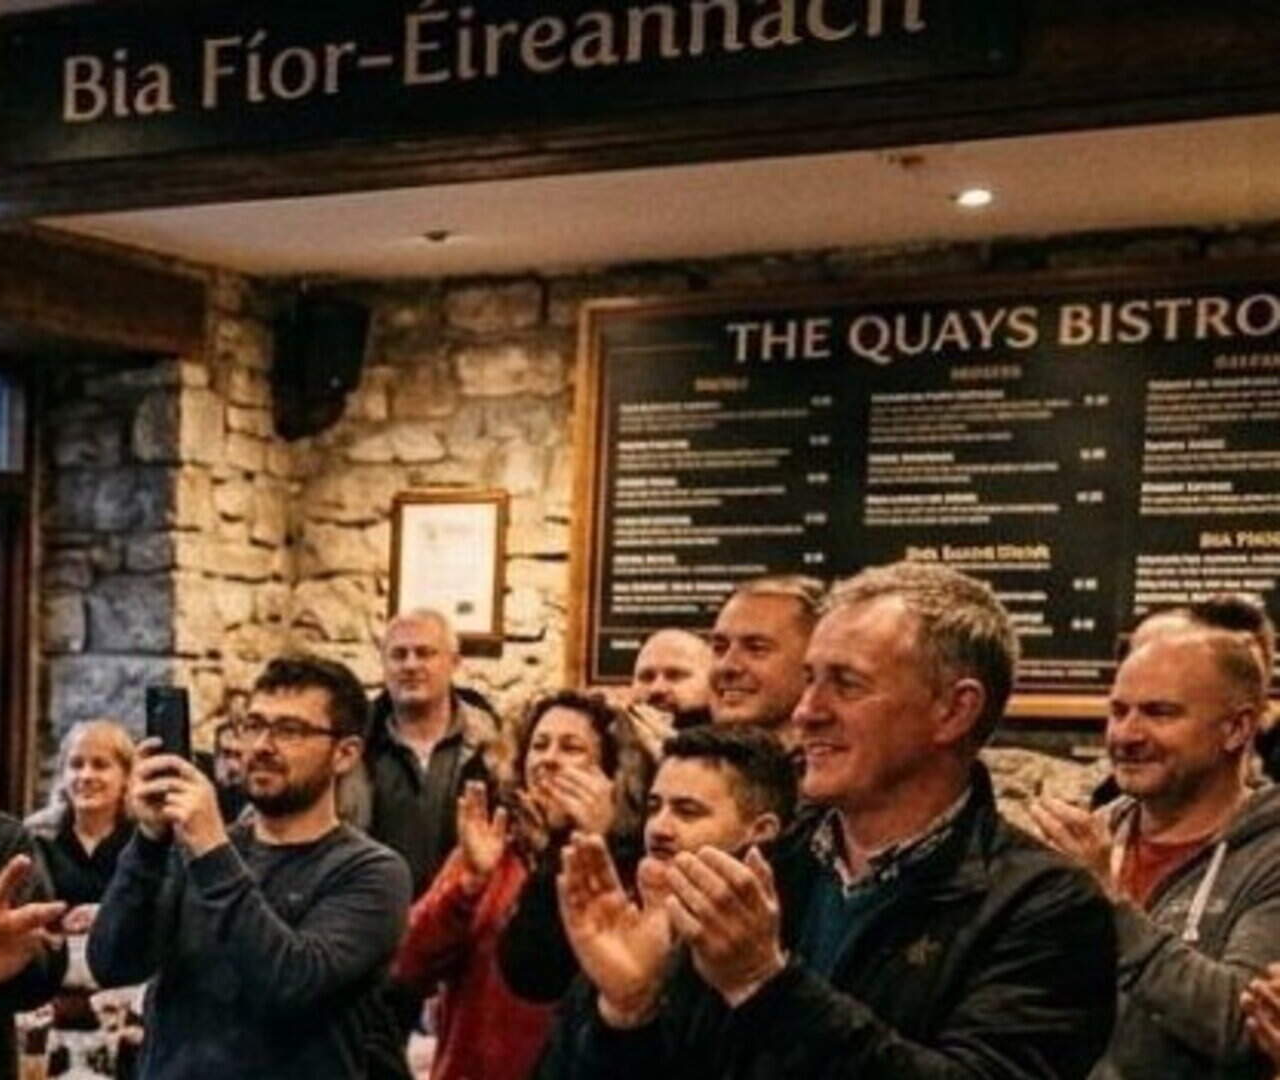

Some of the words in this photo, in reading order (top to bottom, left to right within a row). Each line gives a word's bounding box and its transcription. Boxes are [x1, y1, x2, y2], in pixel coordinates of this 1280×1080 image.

[62, 47, 177, 124] Bia
[725, 317, 833, 363] THE
[847, 305, 1039, 365] QUAYS
[1057, 293, 1280, 346] BISTRO
